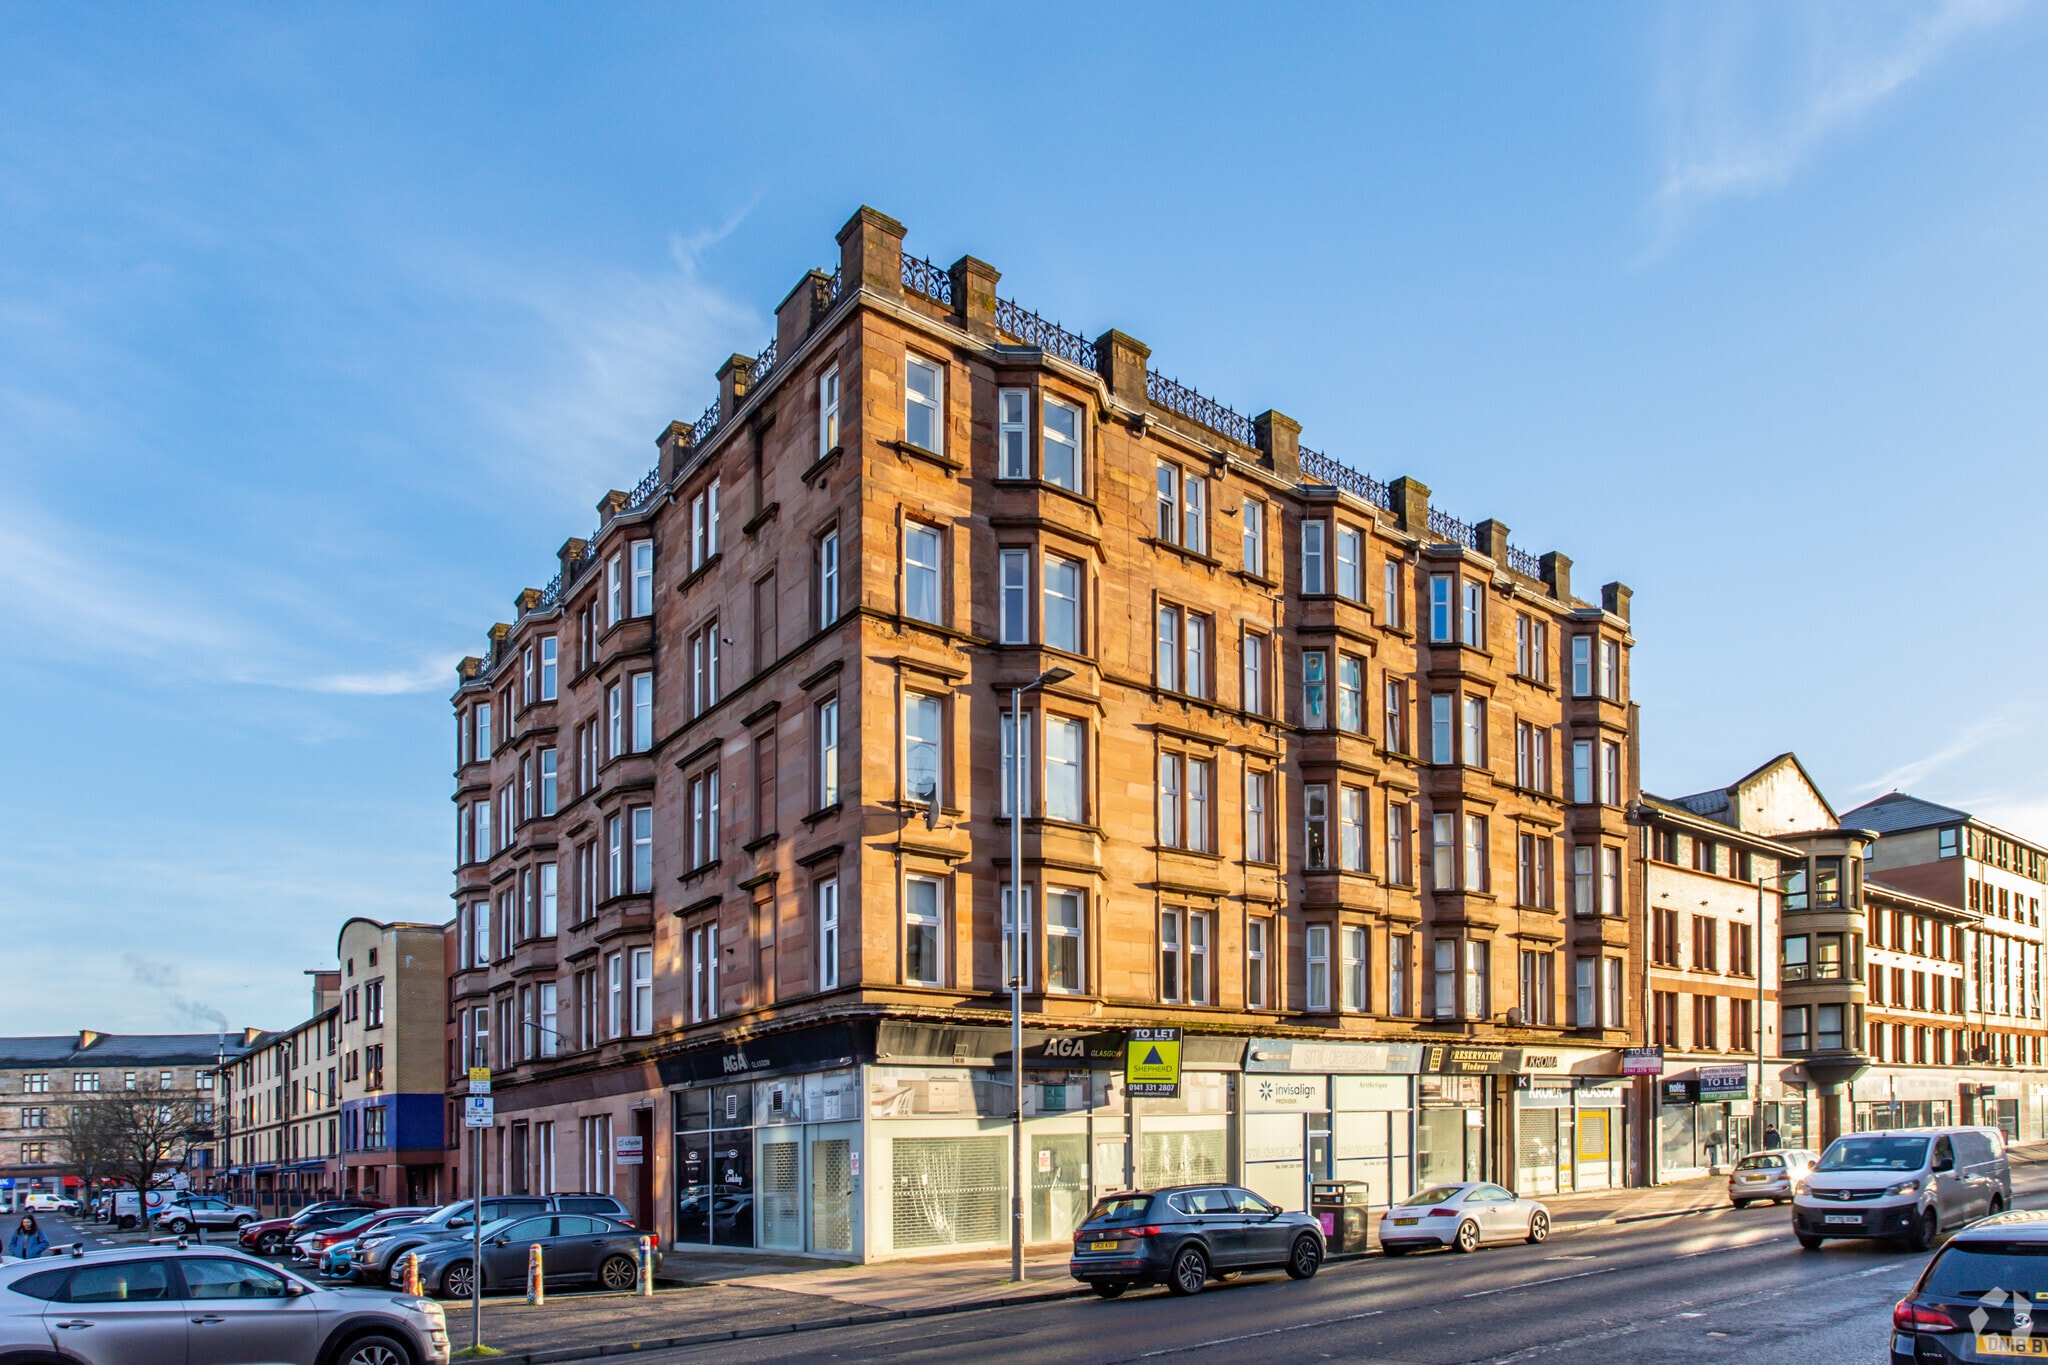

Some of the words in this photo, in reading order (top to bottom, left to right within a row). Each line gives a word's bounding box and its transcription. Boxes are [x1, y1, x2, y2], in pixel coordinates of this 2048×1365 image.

[1134, 1029, 1150, 1038] TO
[1154, 1029, 1175, 1038] LET
[1043, 1038, 1085, 1057] AGA
[1450, 1050, 1504, 1061] PRESERVATION
[722, 1053, 748, 1073] AGA
[751, 1060, 771, 1068] GLASGOW
[1527, 1055, 1558, 1068] KROMA
[1133, 1065, 1173, 1073] SHEPHERD
[1462, 1062, 1488, 1072] Windows
[1518, 1077, 1527, 1086] K
[1707, 1079, 1721, 1087] TO
[1723, 1077, 1740, 1086] LET
[1276, 1084, 1316, 1098] invisalign
[1668, 1082, 1686, 1092] nolte
[477, 1099, 484, 1107] P
[624, 1139, 641, 1147] clyde
[1988, 1336, 2026, 1352] DN18
